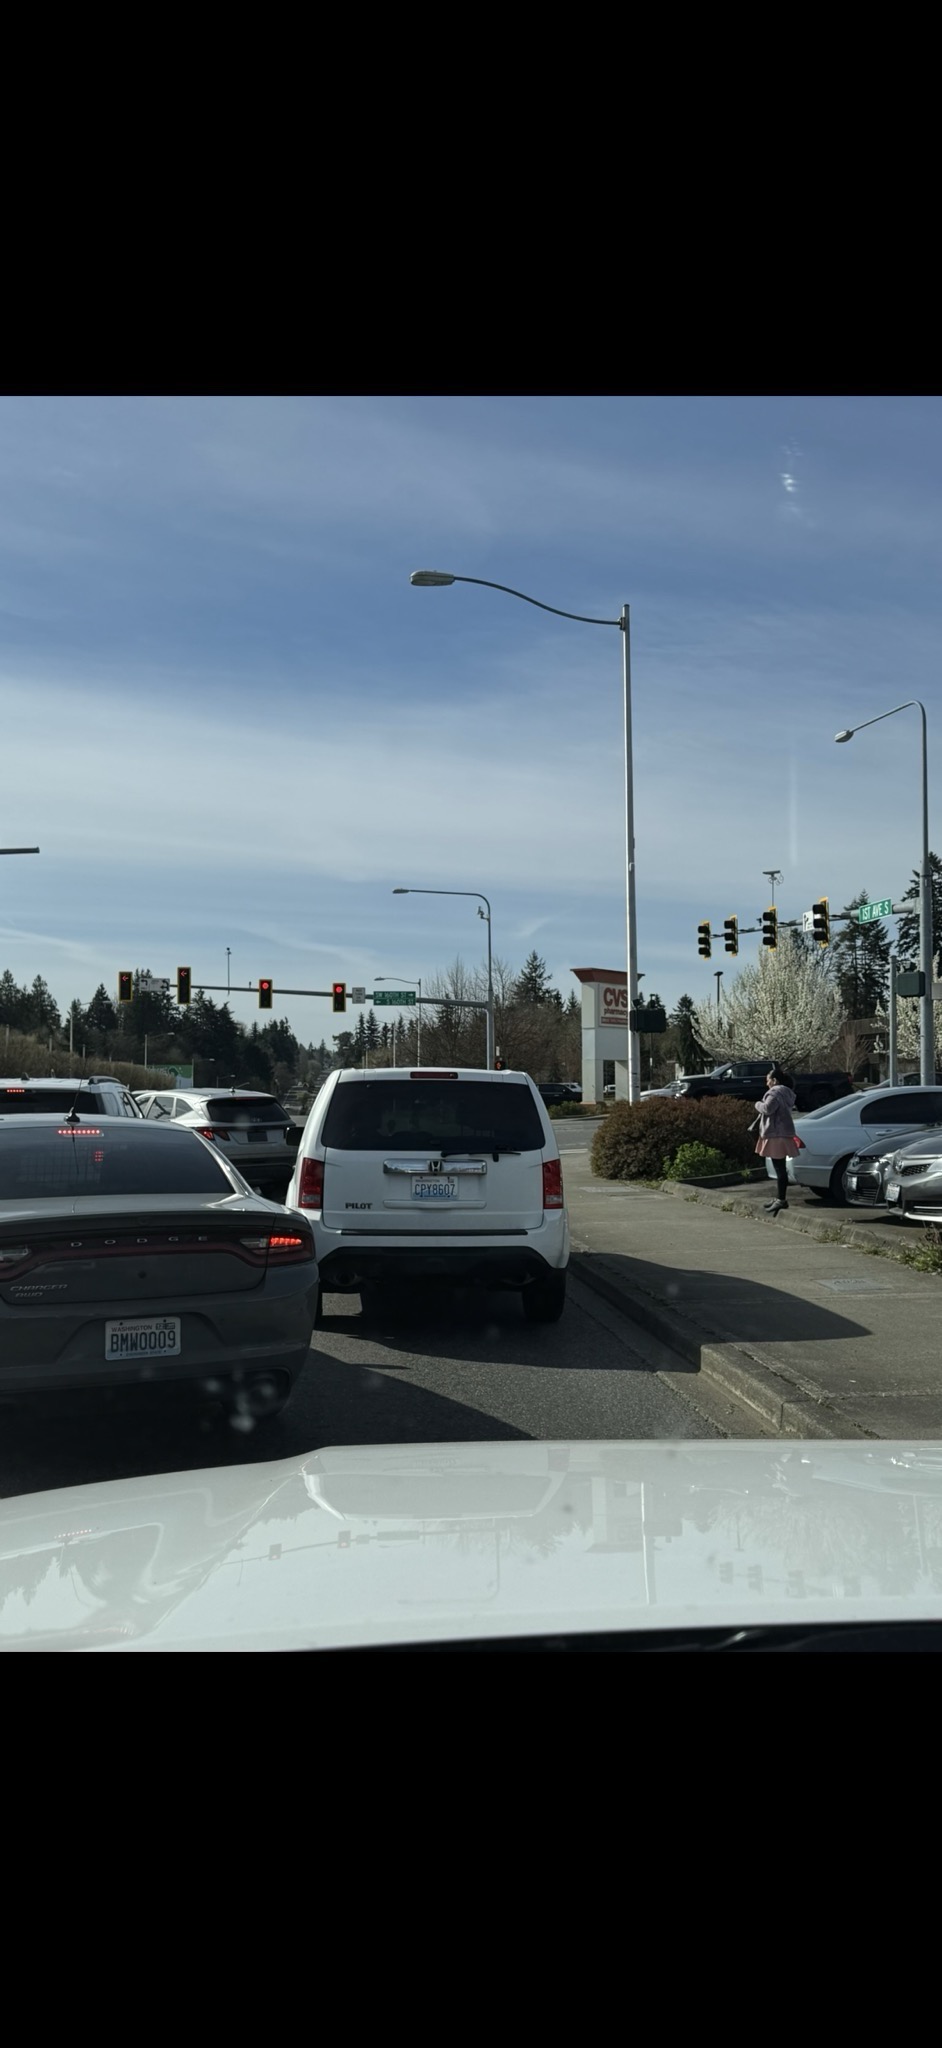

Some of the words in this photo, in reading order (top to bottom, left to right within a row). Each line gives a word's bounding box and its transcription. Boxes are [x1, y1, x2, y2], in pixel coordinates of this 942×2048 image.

[862, 906, 871, 920] 1ST
[872, 903, 883, 918] AVE
[884, 901, 889, 915] S
[603, 987, 628, 1008] CVS
[414, 1183, 456, 1196] CPY8607
[345, 1202, 373, 1210] PILOT
[70, 1236, 208, 1248] DODGE
[111, 1324, 153, 1333] WASHINGTON
[110, 1330, 176, 1353] BMW0009
